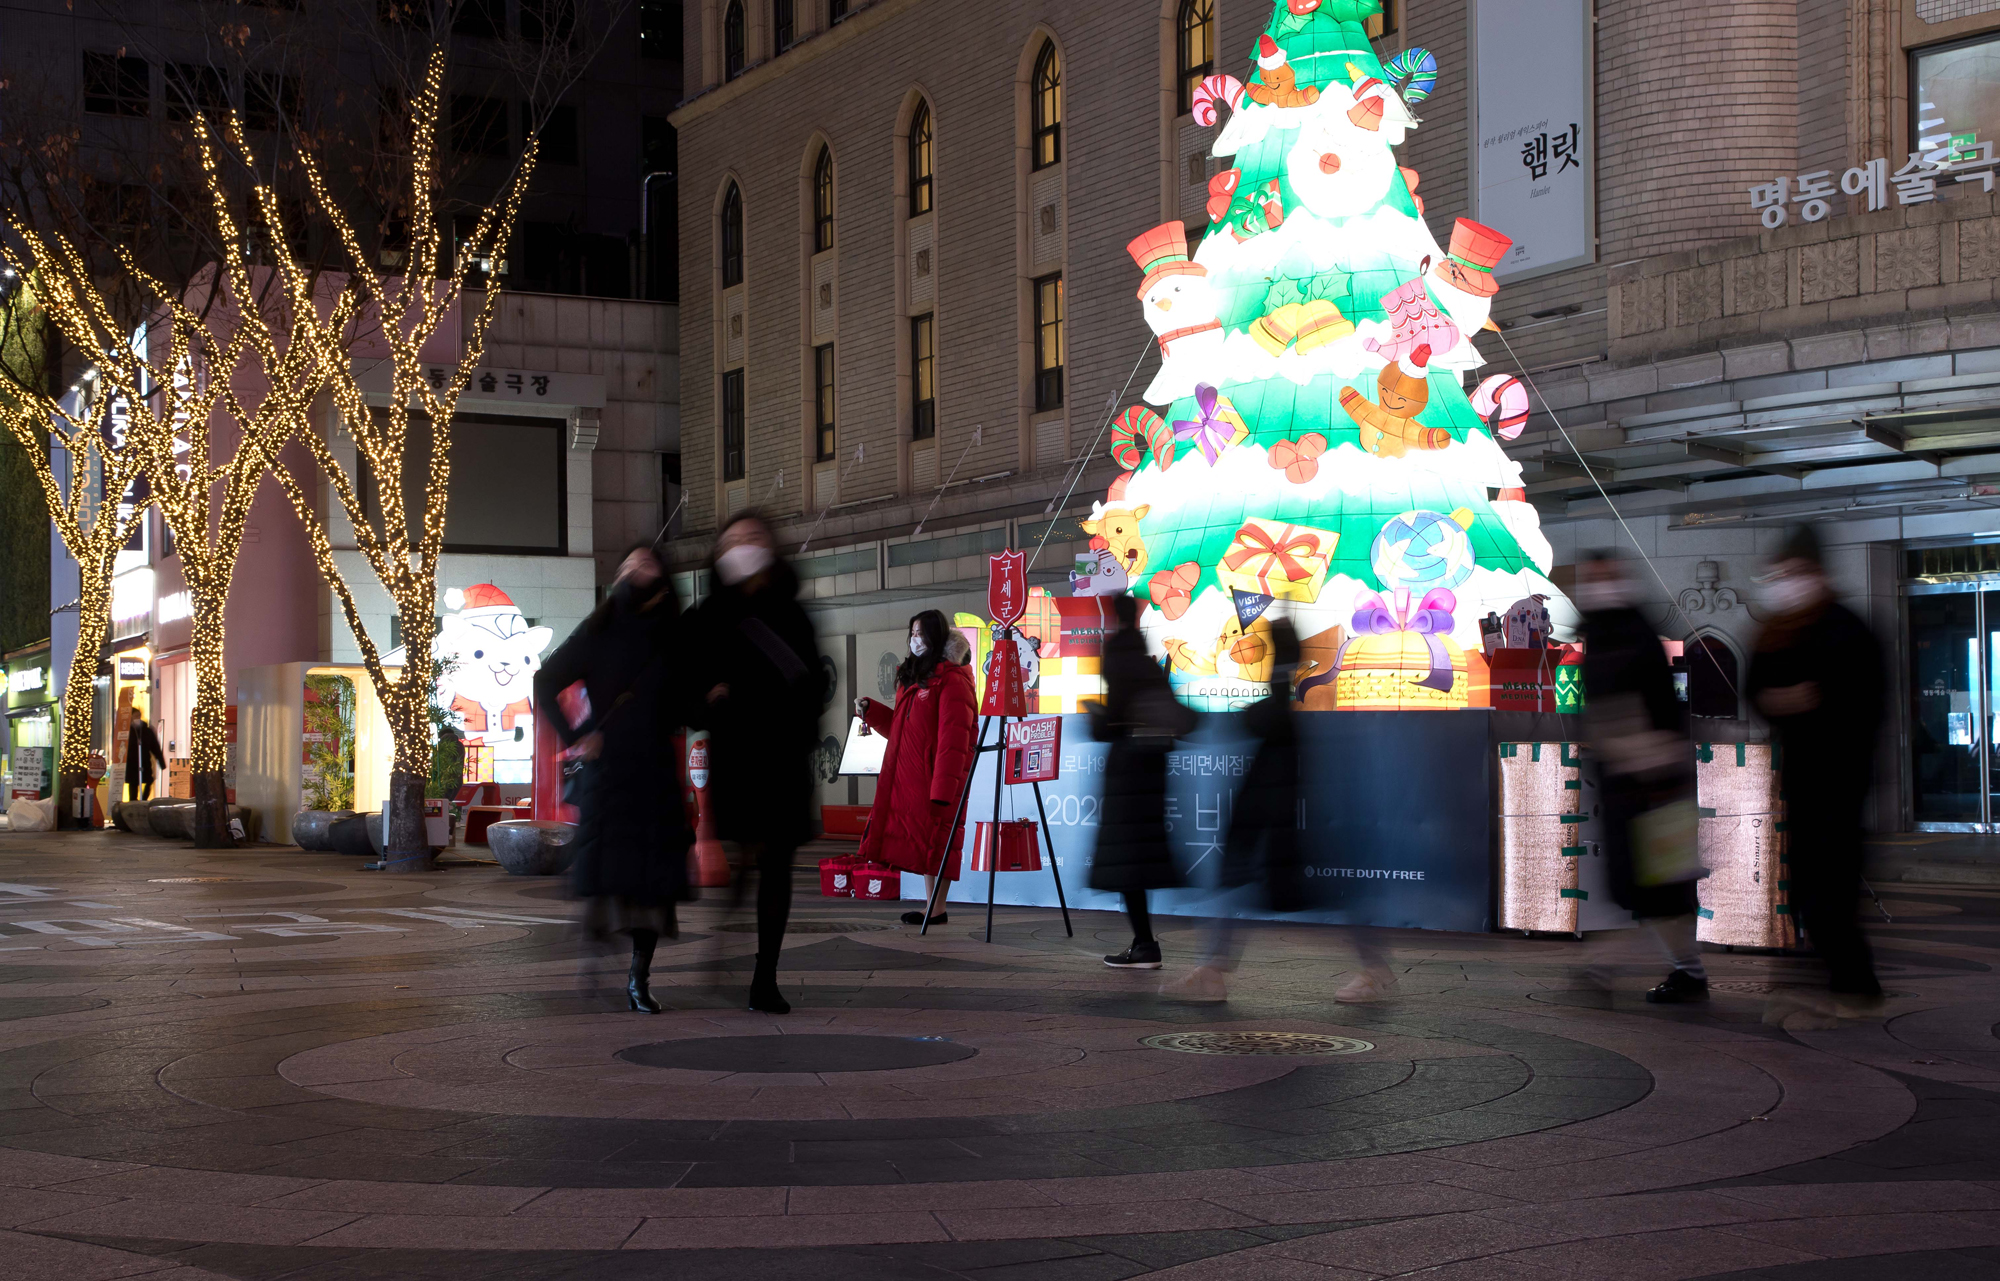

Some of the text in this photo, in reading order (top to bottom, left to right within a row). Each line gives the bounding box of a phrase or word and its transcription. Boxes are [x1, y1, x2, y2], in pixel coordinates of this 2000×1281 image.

[1521, 123, 1580, 181] 햄릿
[1530, 185, 1551, 199] Hamlet
[427, 368, 551, 396] 동술극장
[1000, 559, 1013, 619] 구세군
[1238, 594, 1261, 607] VISIT
[1241, 602, 1267, 619] SEOUL
[1068, 637, 1106, 645] MEDIHEA
[1071, 627, 1106, 637] MERRY
[989, 650, 1003, 708] 자선냄비
[1009, 651, 1019, 708] 자선냄비
[1502, 681, 1544, 691] MERRY
[1010, 720, 1057, 744] NO CASH?
[1059, 754, 1106, 776] 로나19
[1045, 794, 1104, 827] 202
[1317, 867, 1425, 881] LOTTE DUTY FREE
